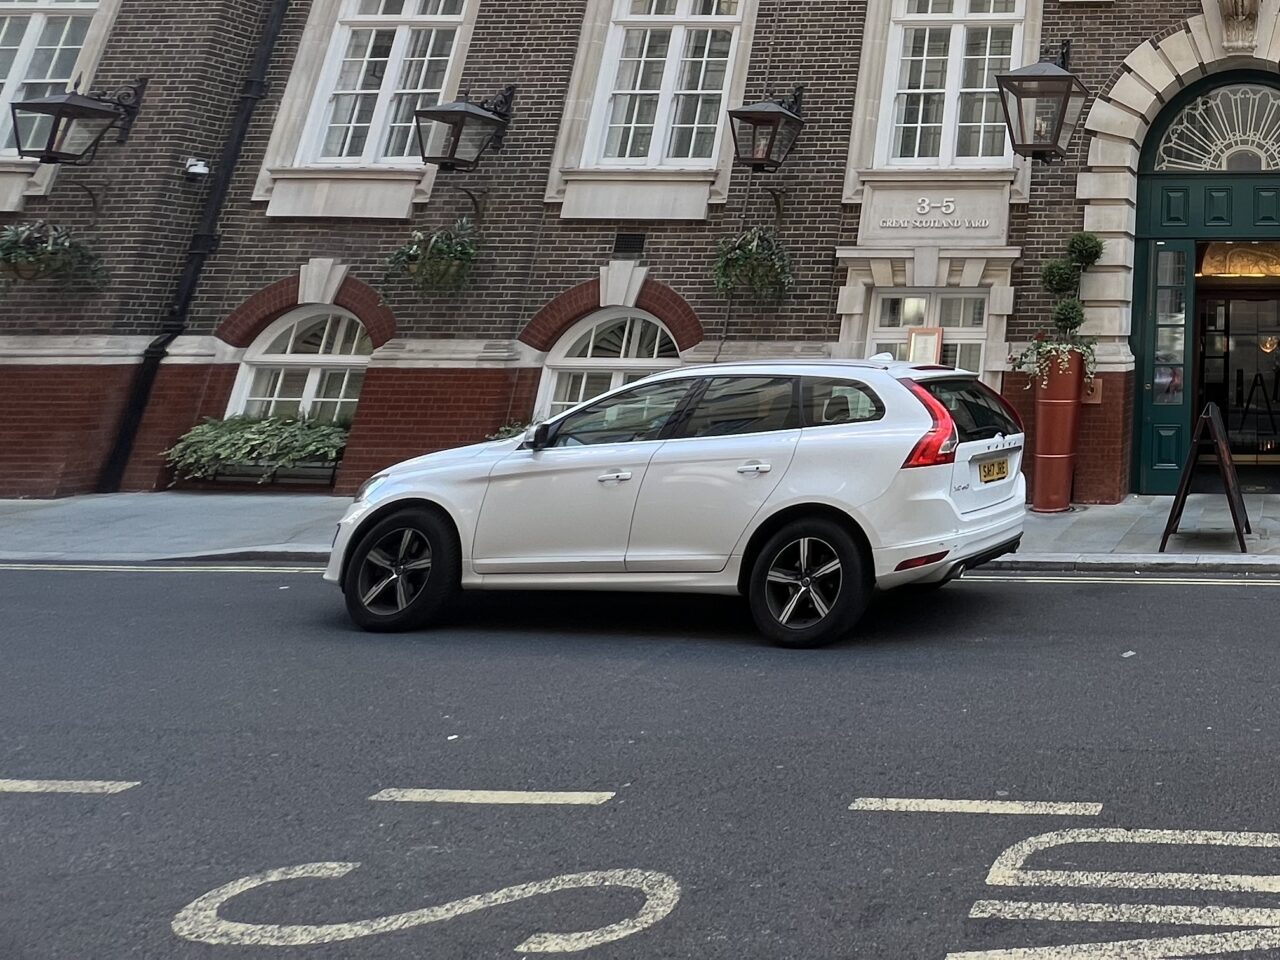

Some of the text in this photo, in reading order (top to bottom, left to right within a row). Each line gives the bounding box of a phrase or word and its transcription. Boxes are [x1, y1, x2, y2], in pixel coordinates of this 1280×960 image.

[916, 197, 956, 215] 3-5
[880, 219, 990, 229] GREAT SCOTLAND YARD
